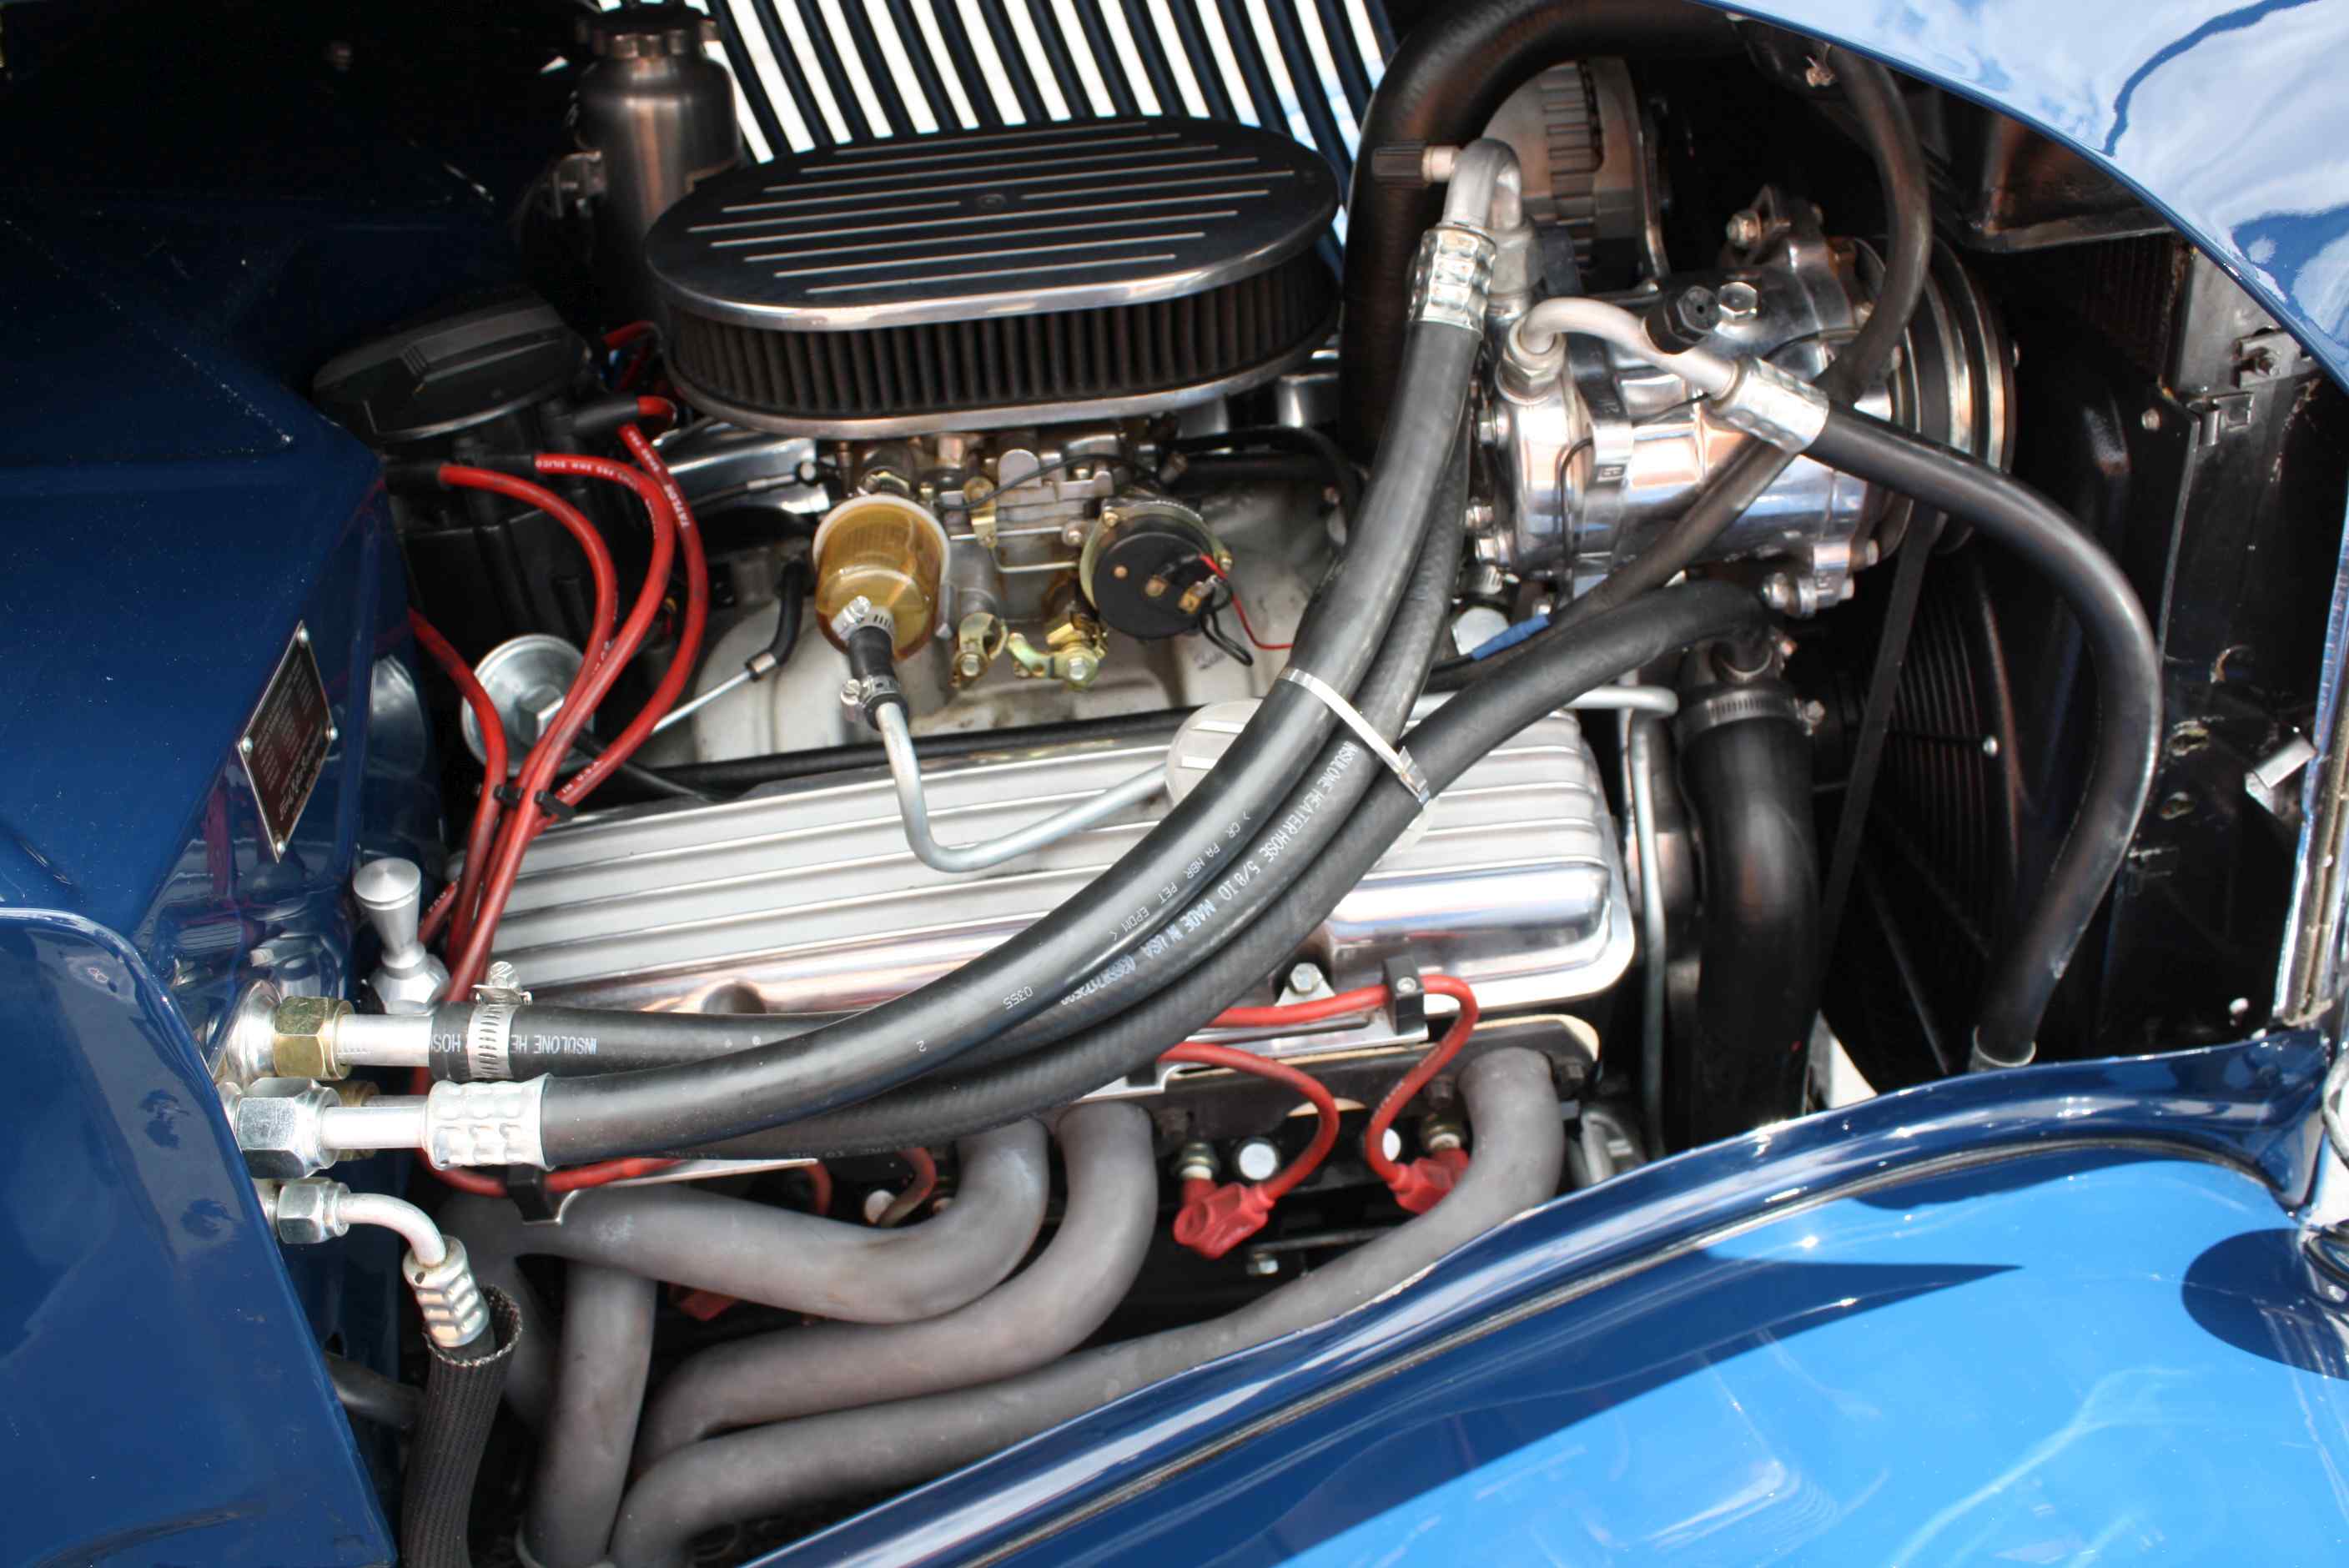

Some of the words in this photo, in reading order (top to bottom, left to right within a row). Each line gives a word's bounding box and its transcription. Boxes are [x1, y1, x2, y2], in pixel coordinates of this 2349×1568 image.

[1317, 740, 1360, 792] INSULONE
[1281, 787, 1325, 836] HEATER
[1223, 820, 1242, 839] CR
[1257, 828, 1290, 862] HOSE
[1232, 859, 1261, 887] 5/8
[1154, 880, 1179, 904] PET
[1179, 897, 1217, 933] MADE
[1139, 932, 1170, 961] USA
[533, 1034, 596, 1053] INSULONE
[915, 1039, 927, 1053] 2
